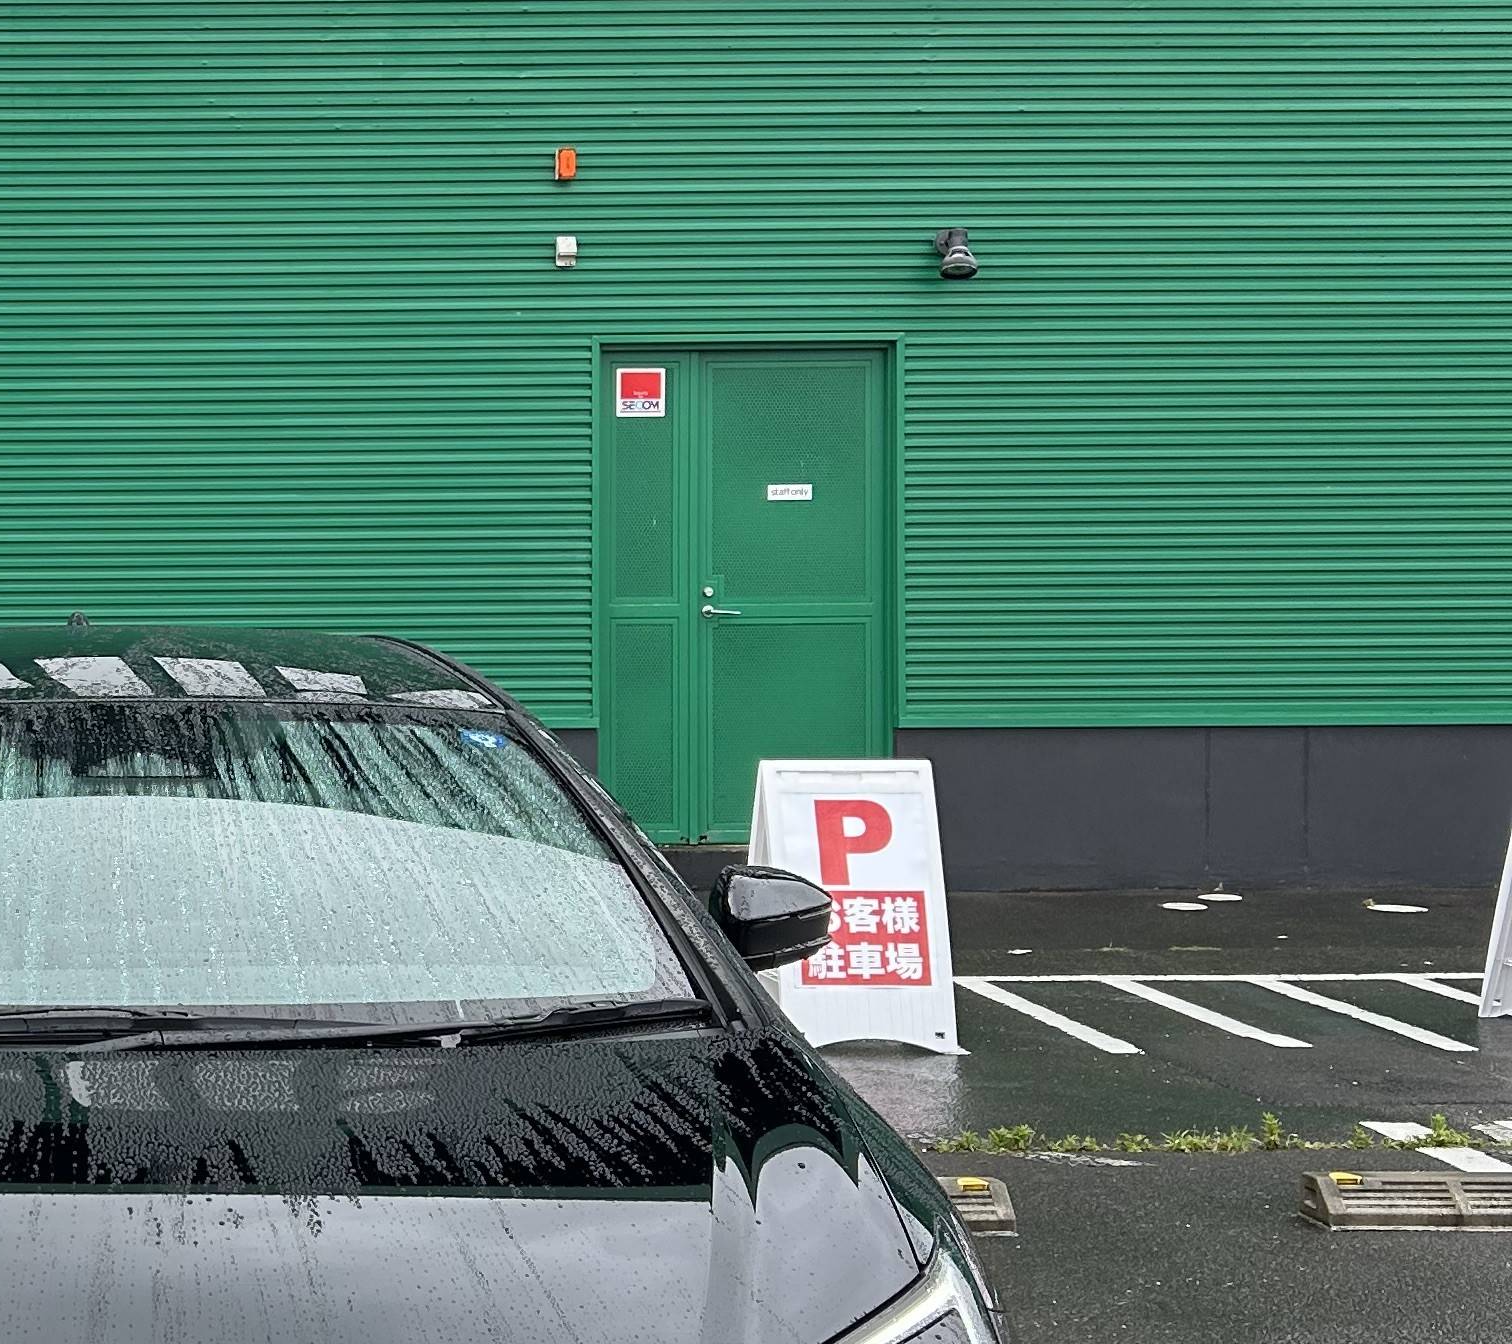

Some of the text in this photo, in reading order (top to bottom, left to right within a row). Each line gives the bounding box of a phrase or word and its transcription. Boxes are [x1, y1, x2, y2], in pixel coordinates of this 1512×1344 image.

[621, 400, 660, 411] SECOM
[790, 488, 809, 497] only
[813, 799, 893, 886] P
[807, 943, 924, 981] 駐車場
